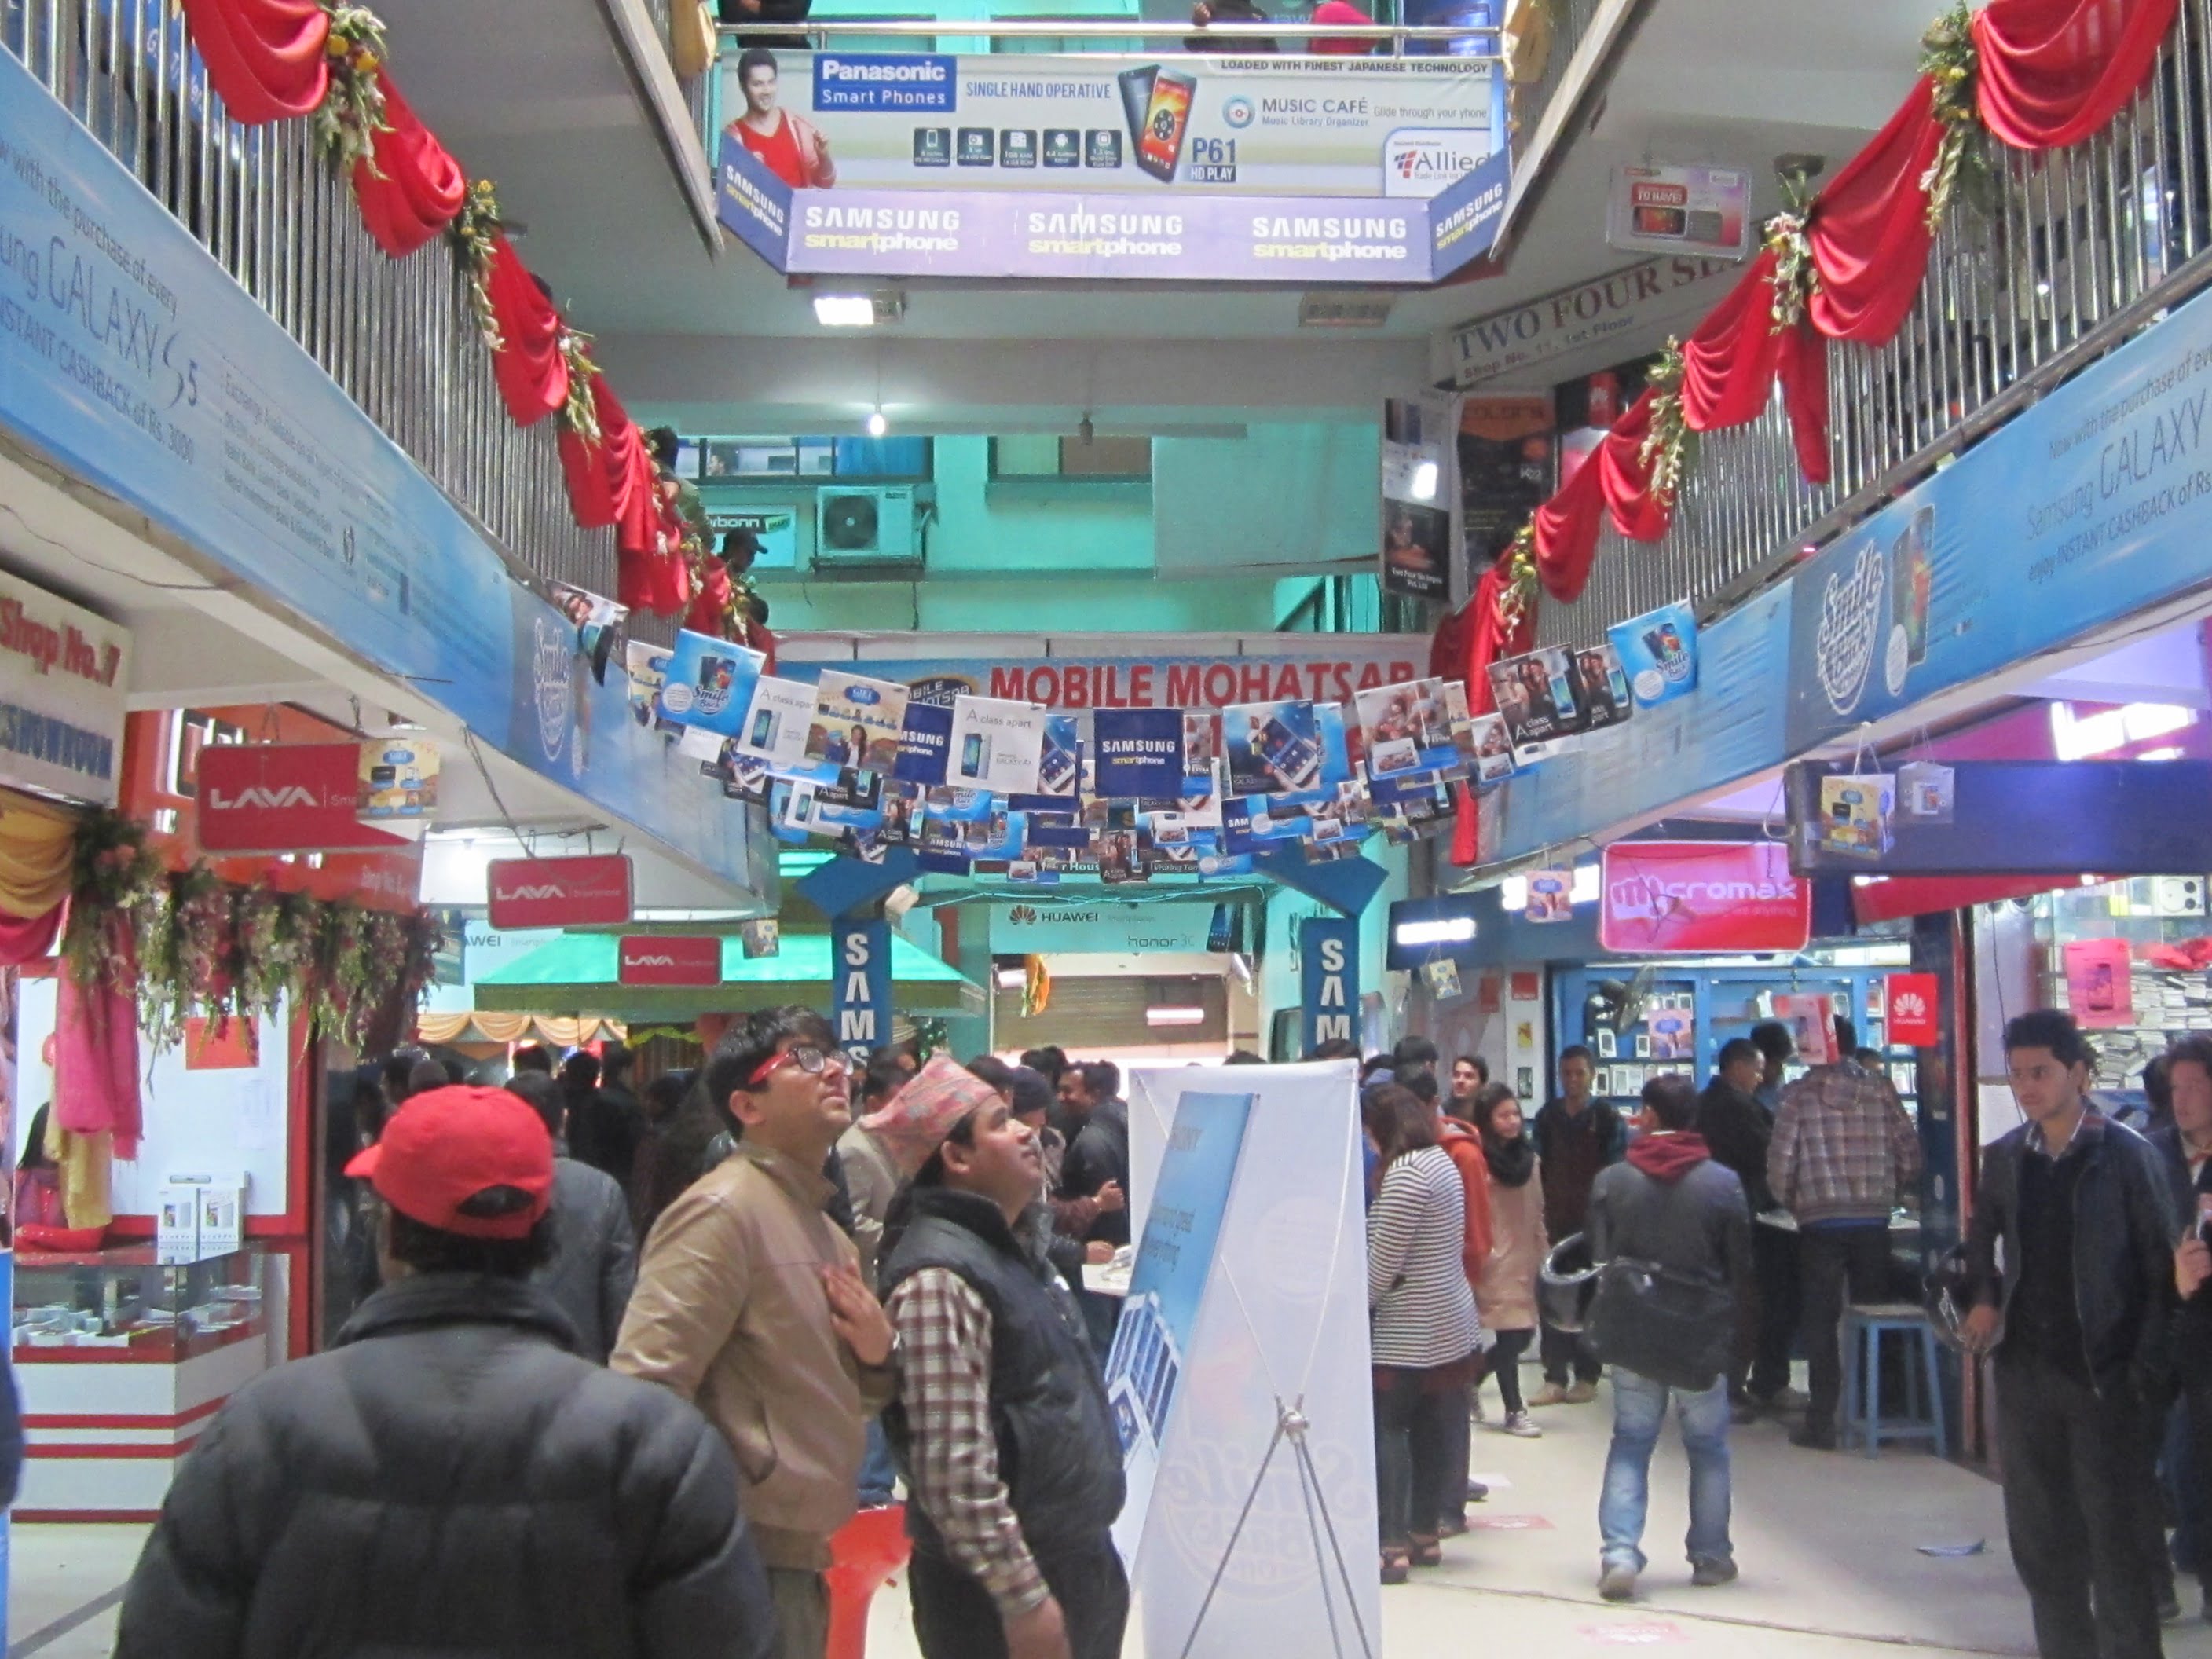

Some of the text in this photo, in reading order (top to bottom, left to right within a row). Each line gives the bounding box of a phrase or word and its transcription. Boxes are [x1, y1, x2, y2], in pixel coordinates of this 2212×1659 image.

[822, 60, 946, 81] Panasonic
[1221, 60, 1488, 74] LOADED WITH FINEST JAPANESE TECHNOLOGY
[822, 89, 946, 104] Smart Phones
[966, 82, 1111, 99] SINGLE HAND OPERATIVE
[1262, 97, 1368, 115] MUSIC CAFÉ
[1374, 106, 1397, 117] Glide
[1399, 107, 1434, 119] through
[1437, 108, 1457, 119] your
[1262, 117, 1288, 126] Music
[1292, 117, 1323, 128] Library
[1192, 137, 1236, 163] P61
[1190, 167, 1234, 181] HD PLAY
[726, 165, 784, 224] SAMSUNG
[726, 184, 782, 236] smartphone
[805, 207, 960, 230] SAMSUNG
[1435, 183, 1503, 237] SAMSUNG
[1029, 213, 1183, 235] SAMSUNG
[1253, 217, 1407, 239] SAMSUNG
[1436, 200, 1503, 251] smartphone
[804, 233, 958, 253] smartphone
[1028, 237, 1183, 258] smartphone
[1253, 240, 1407, 261] smartphone
[74, 207, 130, 275] purchase
[147, 273, 177, 322] every
[0, 225, 198, 409] ung GALAXY S5
[1453, 309, 1540, 361] TWO
[1548, 266, 1664, 330] FOUR
[1463, 361, 1498, 379] Shop
[1593, 315, 1635, 336] Floor
[58, 340, 131, 419] CASHBACK
[2120, 377, 2174, 426] purchase
[2100, 388, 2207, 501] GALAXY
[710, 516, 760, 528] rbonn
[2055, 518, 2108, 566] INSTANT
[2107, 485, 2175, 542] CASHBACK
[0, 597, 59, 676] Shop
[1655, 651, 1690, 675] Smile
[691, 685, 731, 705] Smile
[990, 665, 1154, 708] MOBILE
[760, 687, 814, 710] A class apar
[965, 709, 1031, 730] A class apart
[1516, 716, 1550, 741] A class
[1529, 724, 1554, 738] apart
[1102, 740, 1176, 753] SAMSUNG
[1112, 755, 1166, 765] smartphone
[210, 786, 318, 809] LAVA
[955, 789, 977, 799] mile
[1228, 818, 1249, 828] SAM
[930, 837, 966, 849] AMSUN
[1069, 862, 1101, 872] Hous
[495, 884, 566, 901] LAVA
[1042, 912, 1099, 923] HUAWEI
[1128, 936, 1177, 947] honor
[624, 955, 675, 967] LAVA
[841, 932, 875, 1068] SAMS
[1317, 939, 1350, 1046] SAM
